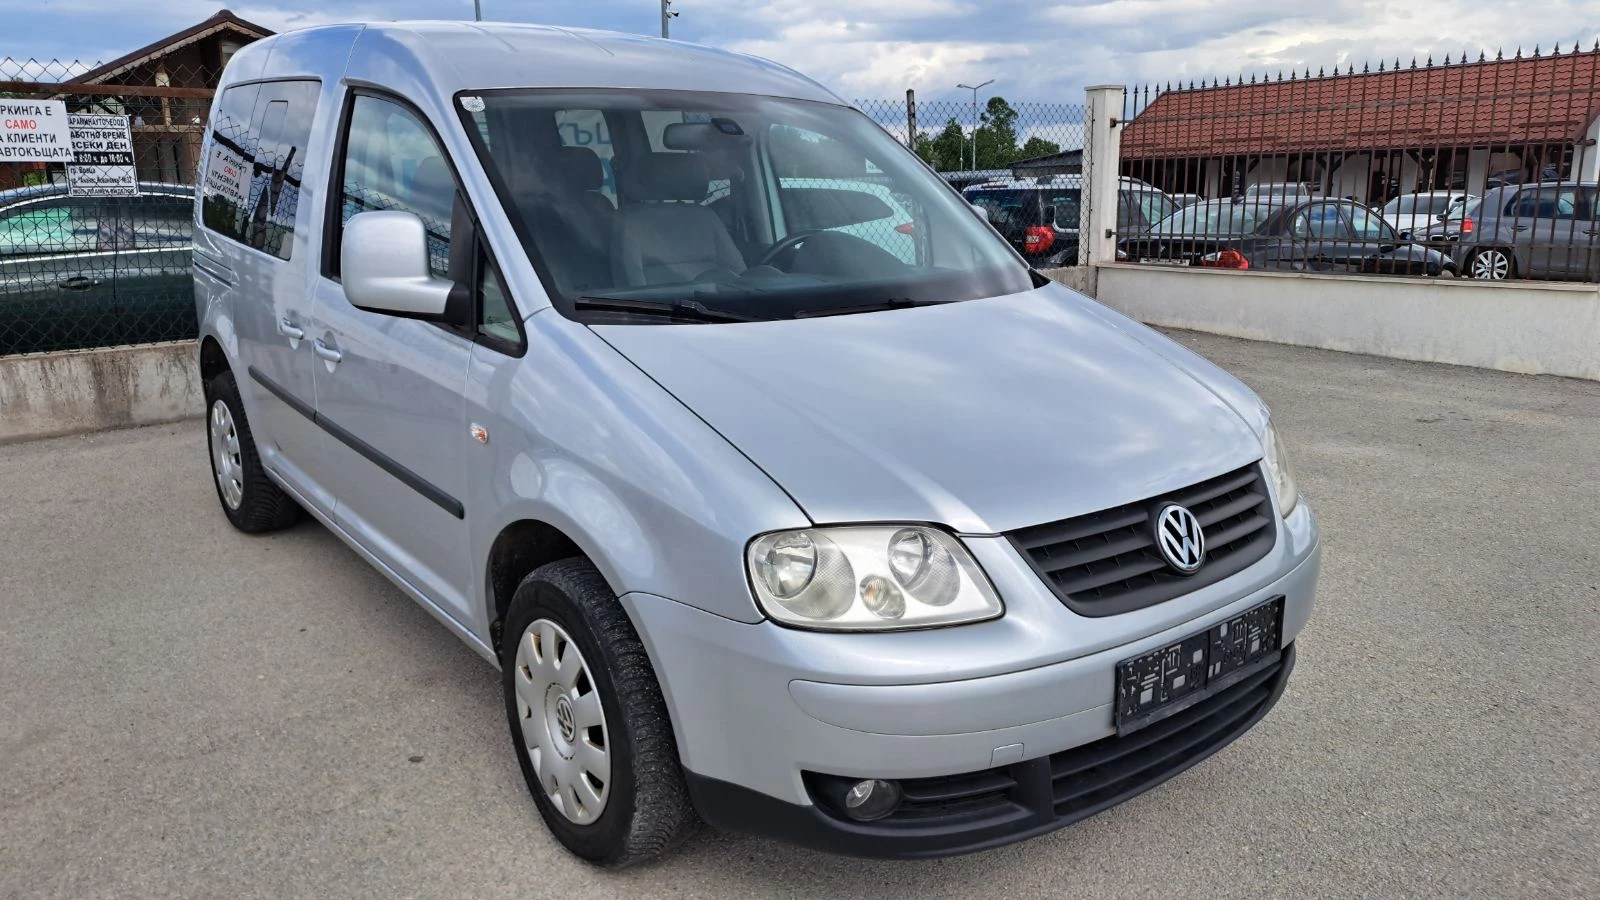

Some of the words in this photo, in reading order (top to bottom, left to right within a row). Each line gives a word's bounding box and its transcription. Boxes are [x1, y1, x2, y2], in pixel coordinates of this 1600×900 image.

[45, 106, 52, 116] Е
[5, 119, 37, 129] САМО
[7, 133, 57, 144] КЛИЕНТИ
[102, 132, 127, 140] ВРЕМЕ
[106, 142, 128, 150] ДЕН
